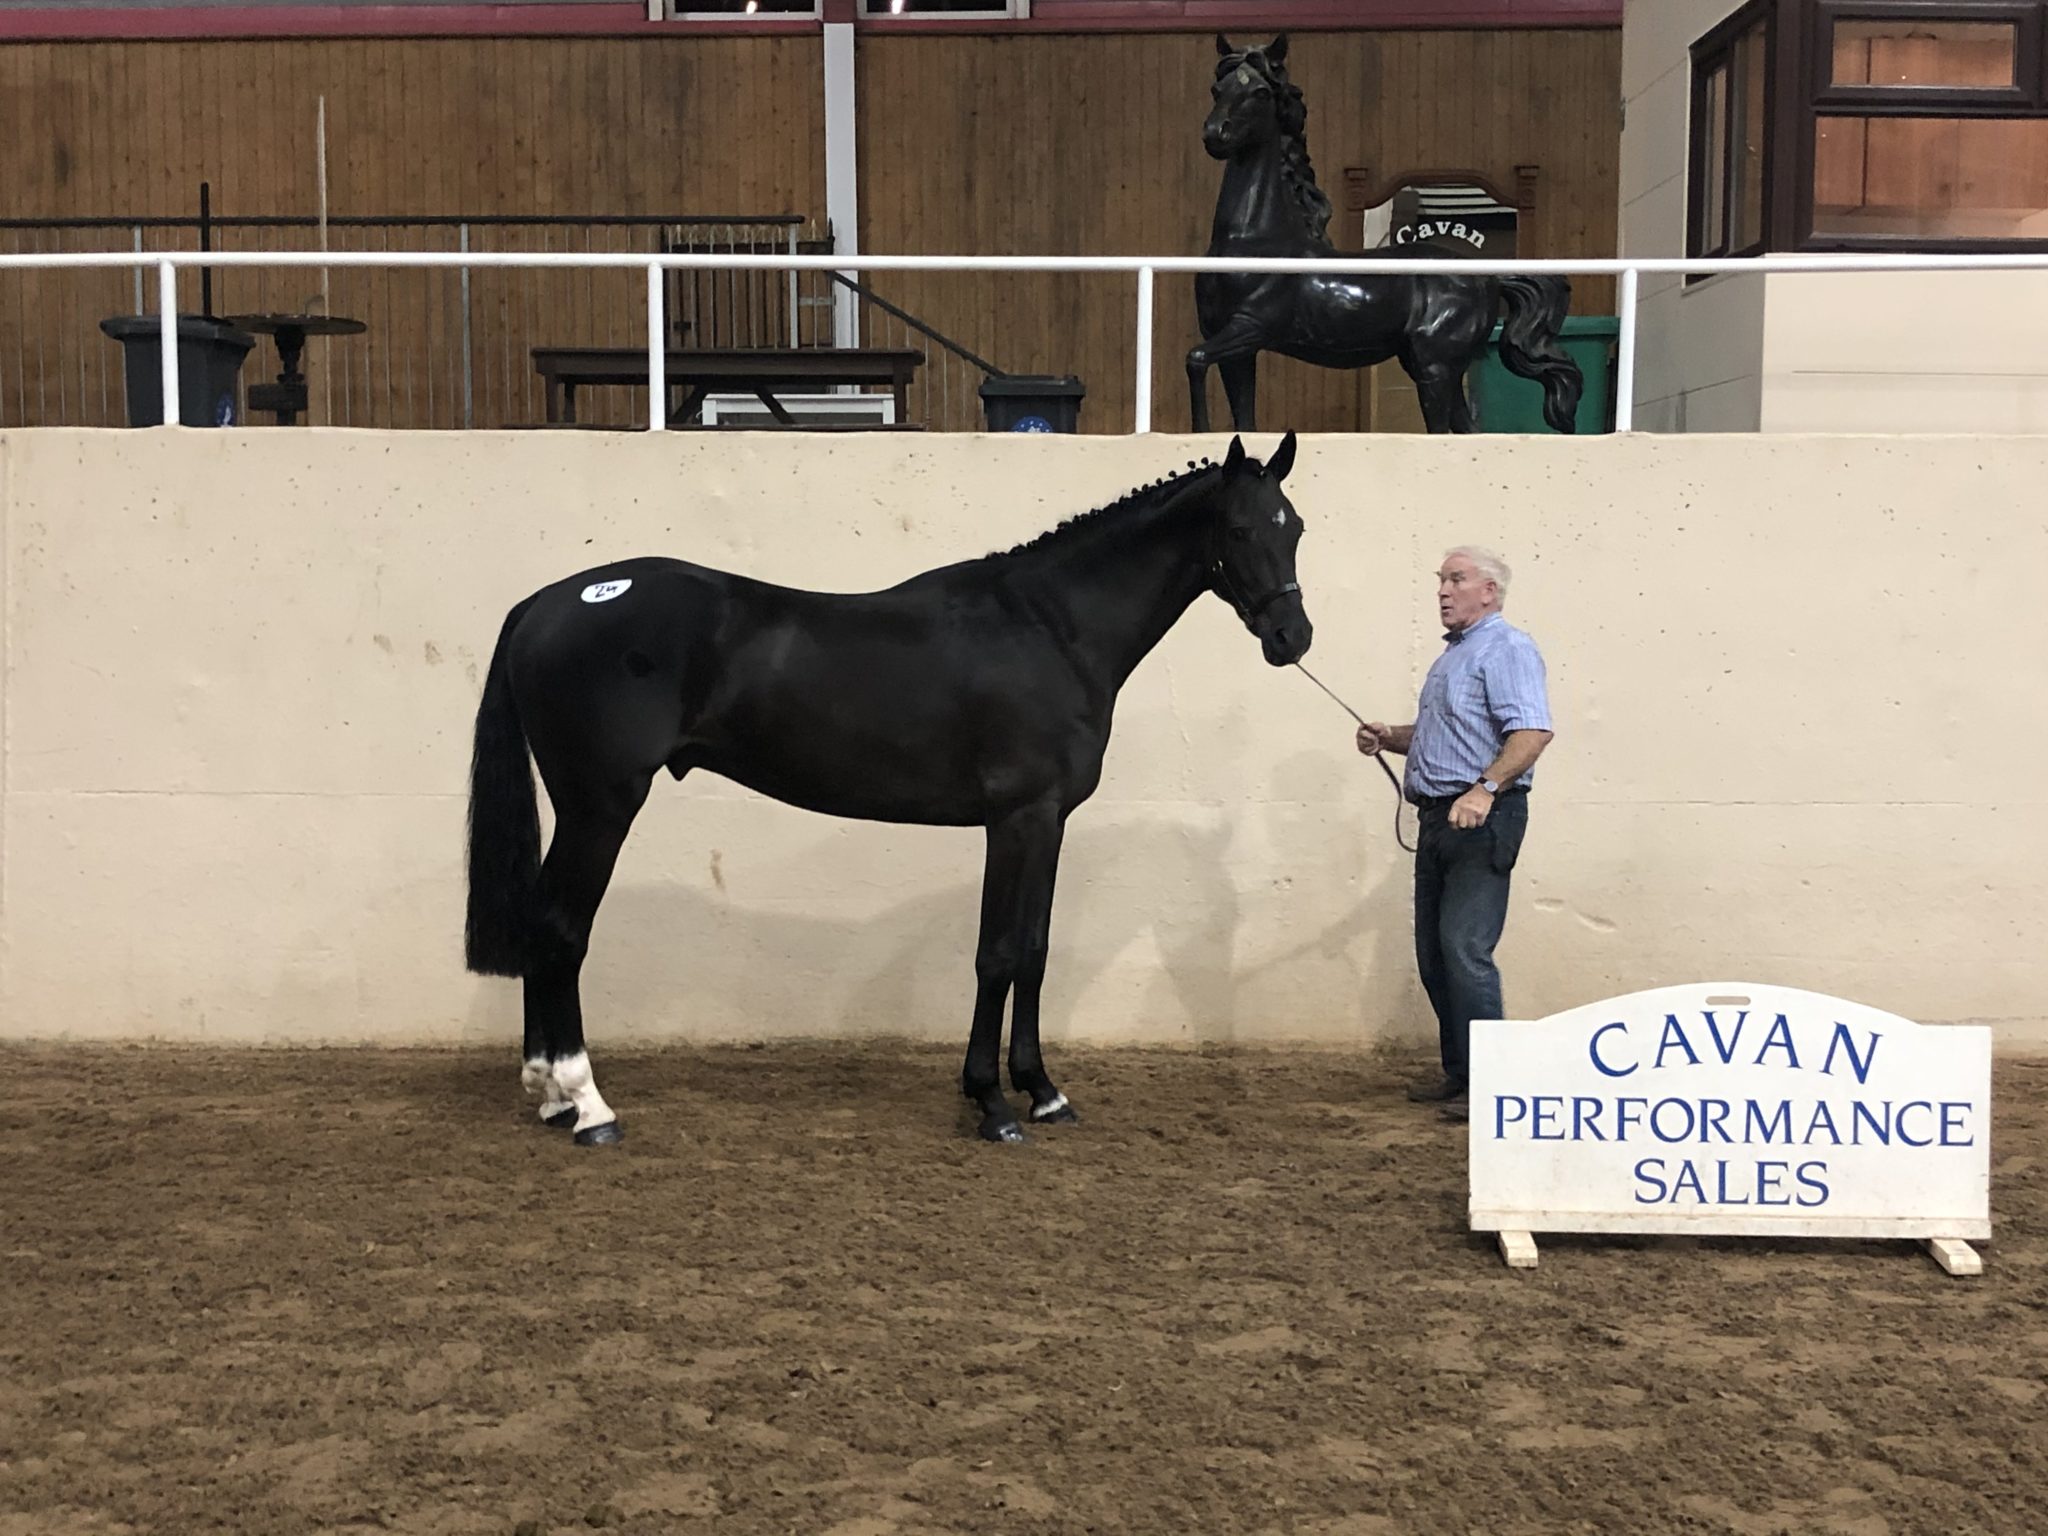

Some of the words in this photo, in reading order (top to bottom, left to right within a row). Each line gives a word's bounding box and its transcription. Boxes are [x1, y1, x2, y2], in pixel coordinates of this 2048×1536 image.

[1396, 221, 1486, 249] Cavan
[595, 585, 618, 598] 24
[1589, 1010, 1883, 1084] CAVAN
[1493, 1095, 1974, 1147] PERFORMANCE
[1633, 1158, 1830, 1207] SALES
